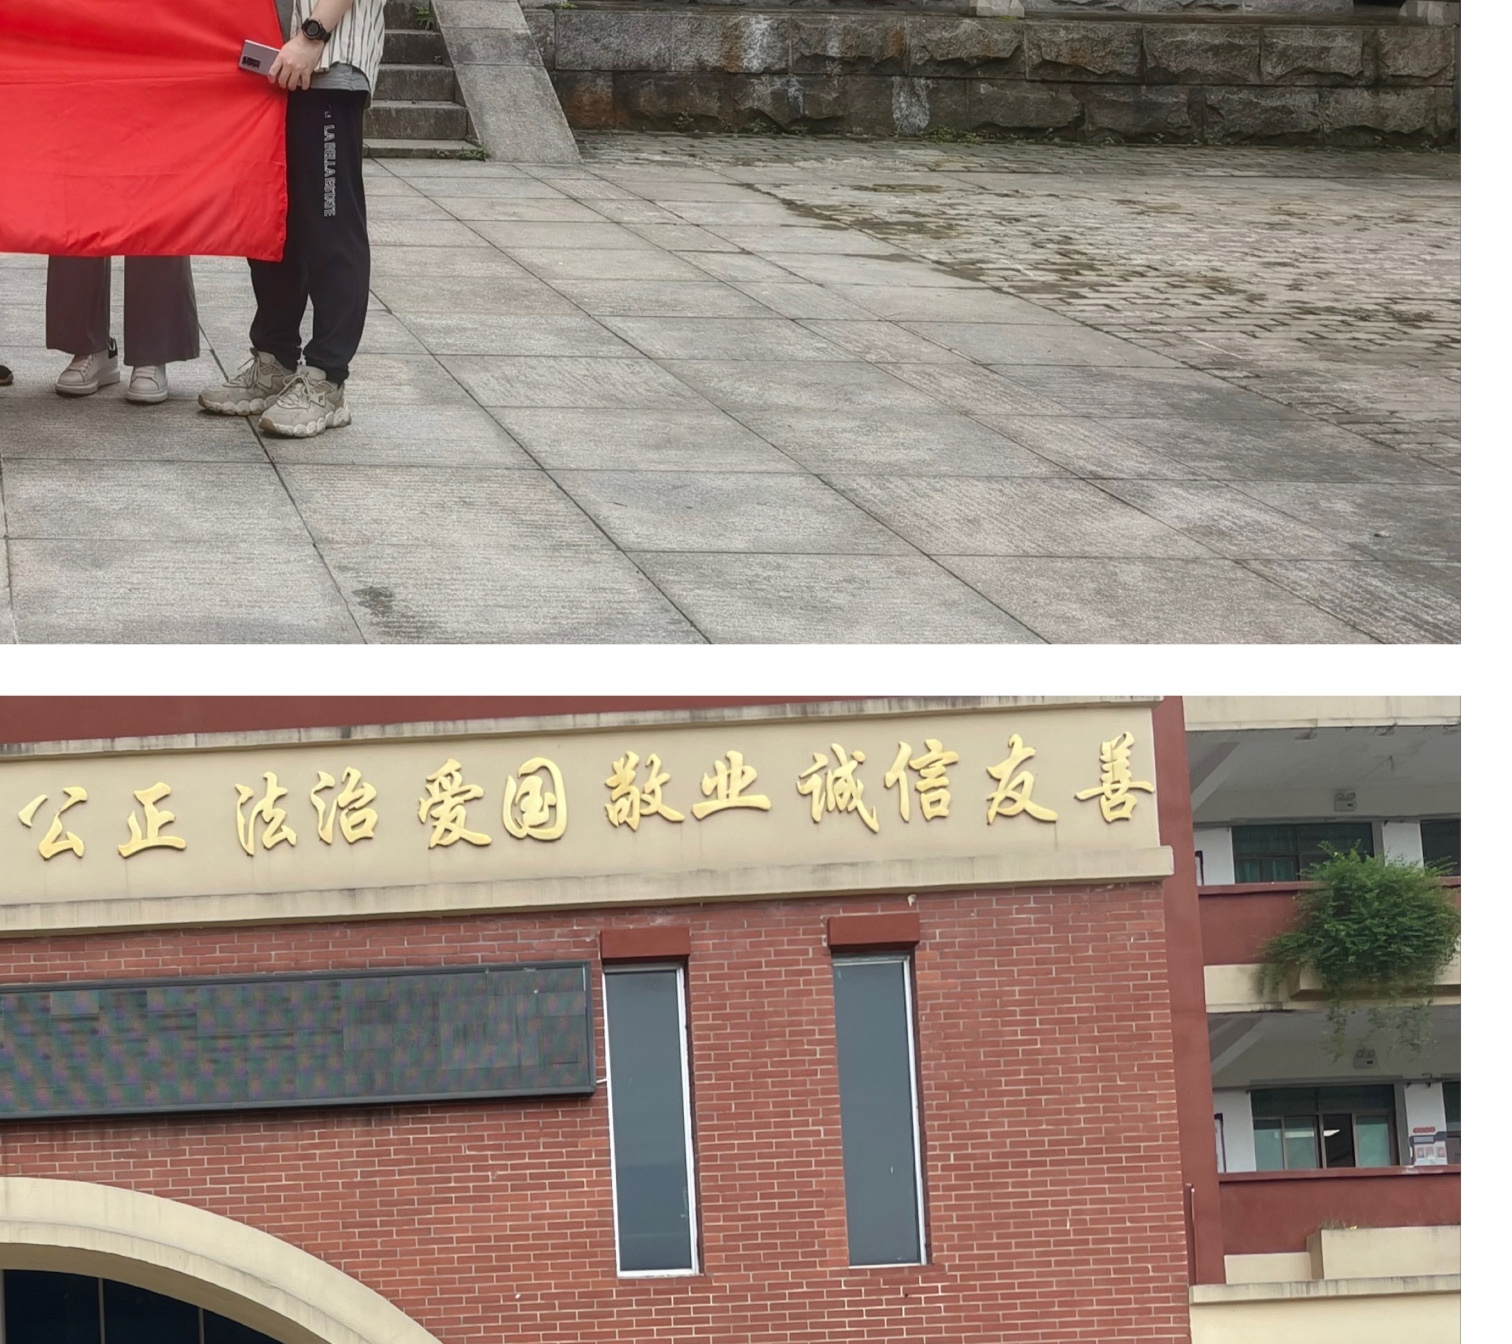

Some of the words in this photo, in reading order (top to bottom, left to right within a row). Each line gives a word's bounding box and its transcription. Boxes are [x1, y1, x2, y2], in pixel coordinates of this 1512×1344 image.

[324, 124, 335, 141] LA
[18, 780, 186, 858] 公正
[234, 766, 381, 854] 法治
[417, 756, 569, 849] 爱国
[603, 748, 772, 825] 敬业
[796, 738, 959, 832] 诚信
[982, 730, 1157, 825] 友善
